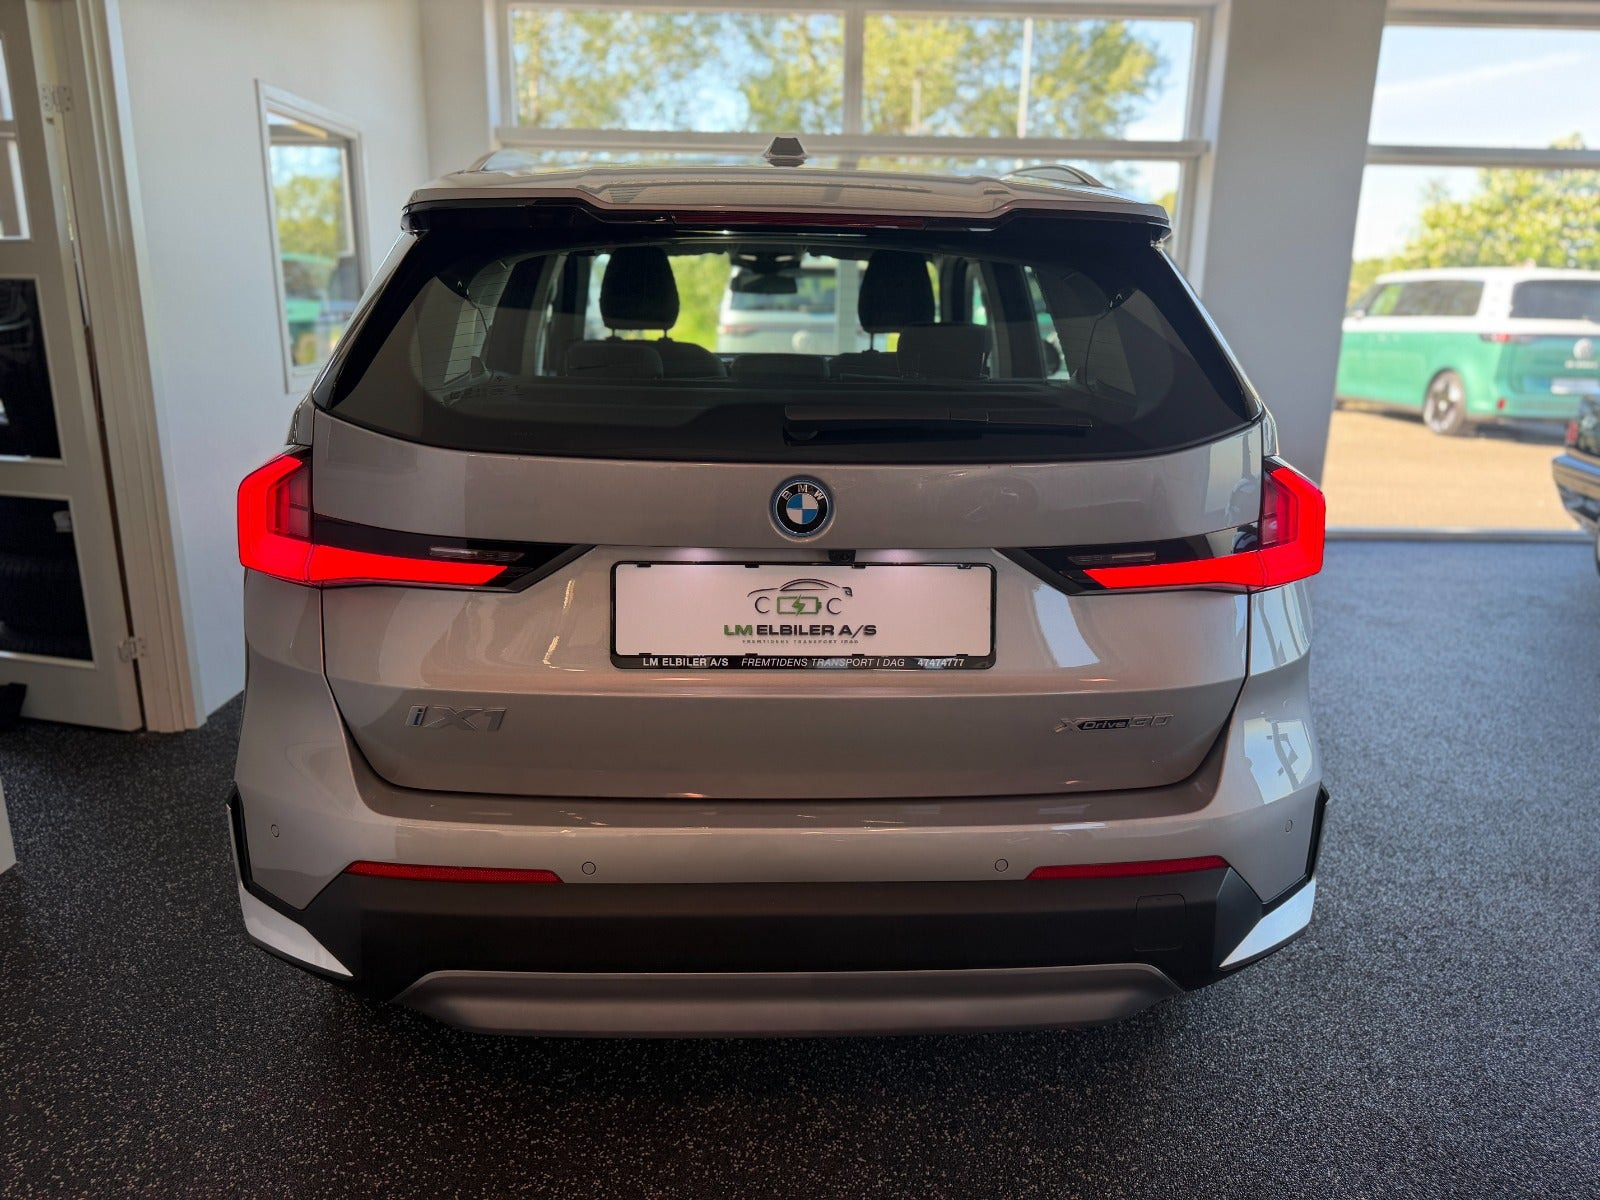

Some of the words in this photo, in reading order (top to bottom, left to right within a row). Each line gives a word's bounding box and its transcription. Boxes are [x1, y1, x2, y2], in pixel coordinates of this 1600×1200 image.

[781, 484, 825, 501] BMW
[724, 624, 753, 637] LM
[756, 624, 835, 637] ELBILER
[838, 624, 877, 638] A/S
[643, 657, 659, 667] LM
[662, 657, 707, 667] ELBILER
[710, 657, 729, 667] A/S
[741, 658, 808, 667] FREMTIDENS
[811, 658, 874, 667] TRANSPORT
[882, 658, 905, 667] DAG
[917, 658, 965, 667] 47474777
